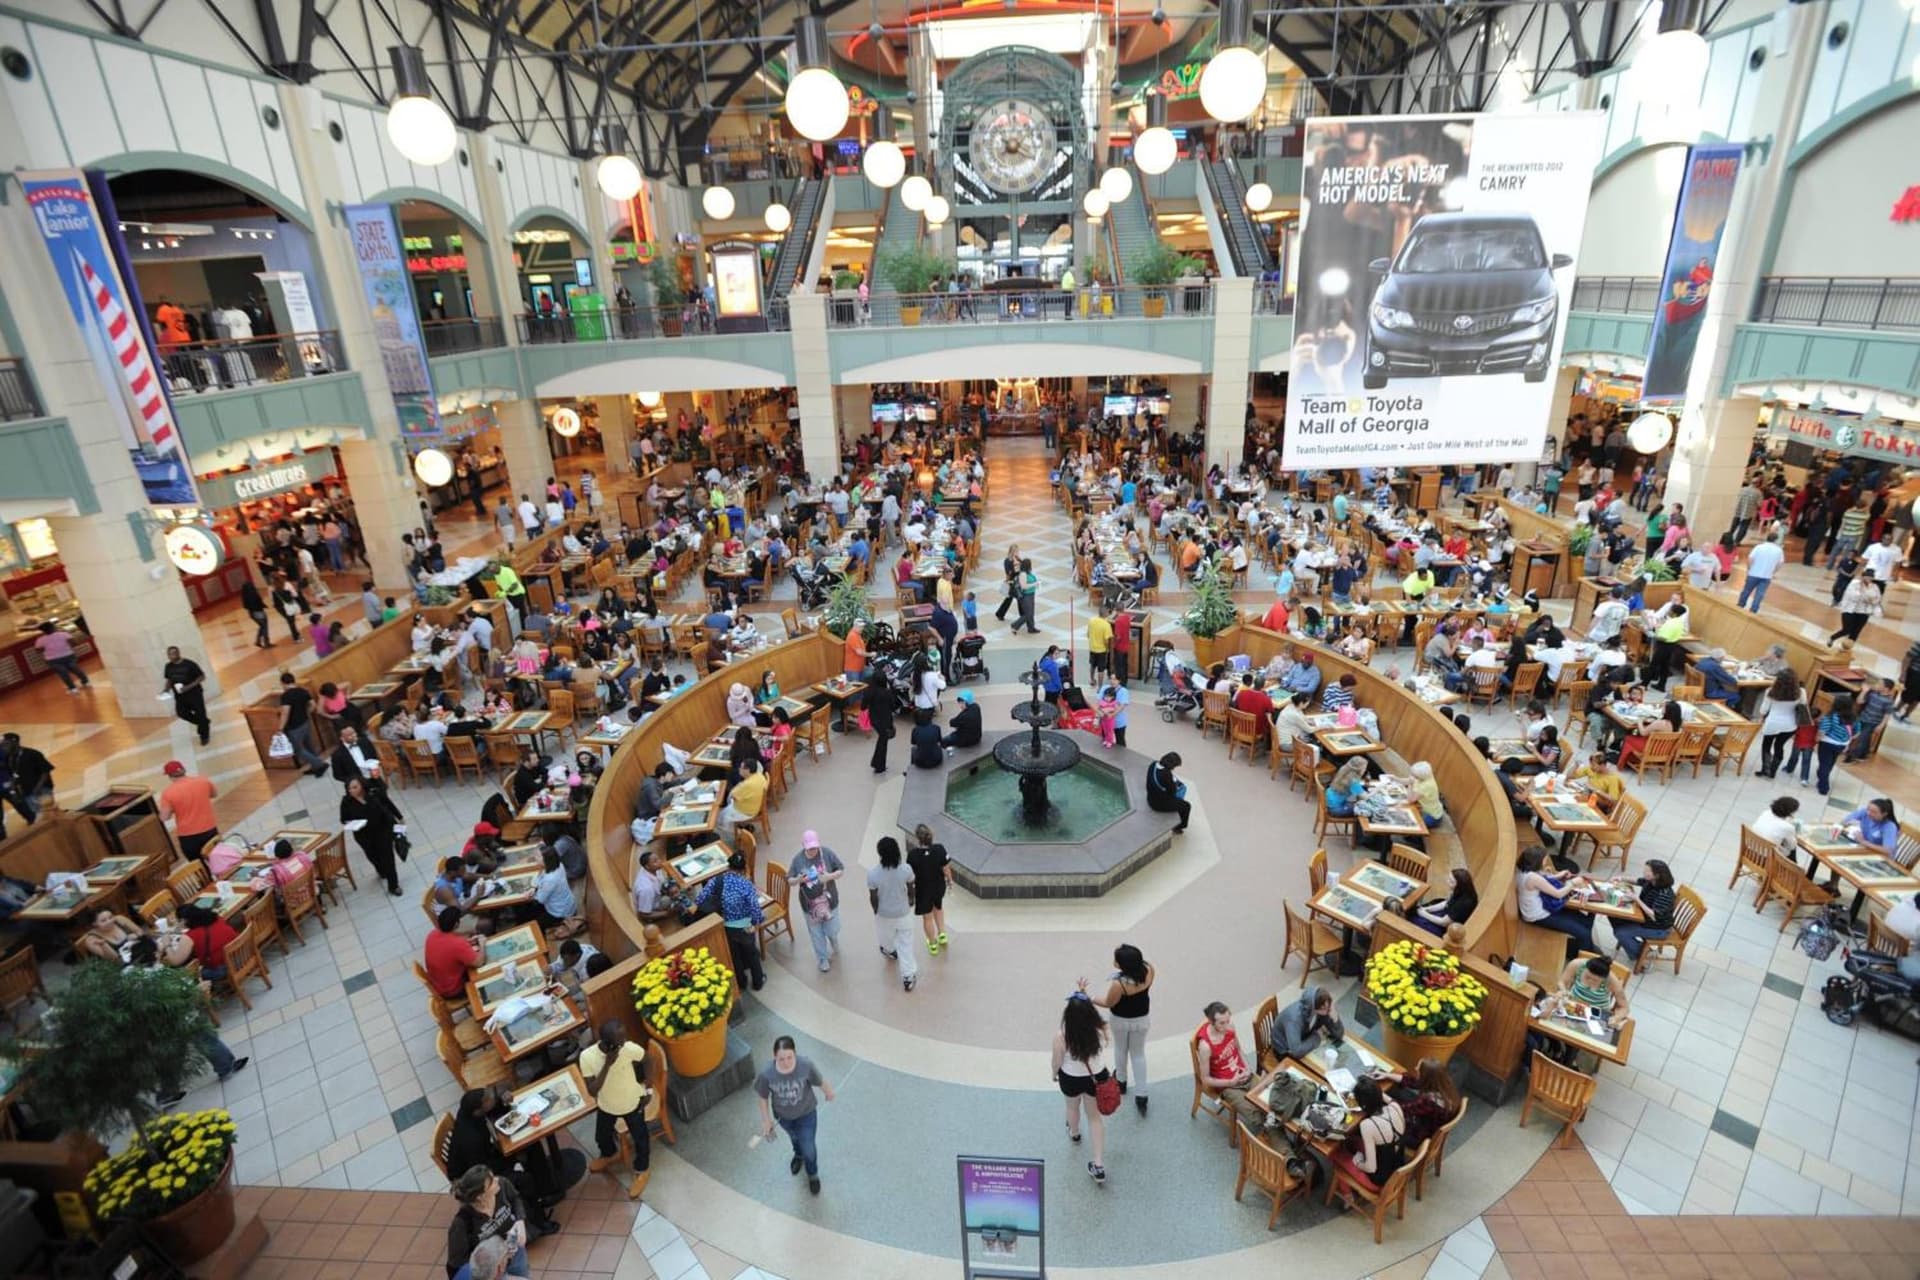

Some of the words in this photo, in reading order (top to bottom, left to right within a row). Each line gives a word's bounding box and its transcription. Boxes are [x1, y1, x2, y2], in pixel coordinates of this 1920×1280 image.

[1320, 167, 1403, 186] AMERICA'S
[1407, 163, 1449, 184] NEXT
[1479, 175, 1526, 191] CAMRY
[1318, 186, 1351, 205] HOT
[1354, 184, 1412, 202] MODEL.
[43, 199, 77, 216] Lake
[35, 205, 88, 238] Lanier
[1300, 398, 1346, 414] Team
[1366, 395, 1423, 415] Toyota
[1298, 419, 1335, 435] Mall
[1340, 417, 1358, 433] of
[1362, 416, 1430, 434] Georgia
[1789, 415, 1832, 440] Little
[1407, 442, 1424, 451] Just
[1427, 441, 1442, 450] One
[1445, 440, 1460, 449] Mile
[1464, 439, 1482, 449] West
[1510, 437, 1528, 447] Mall
